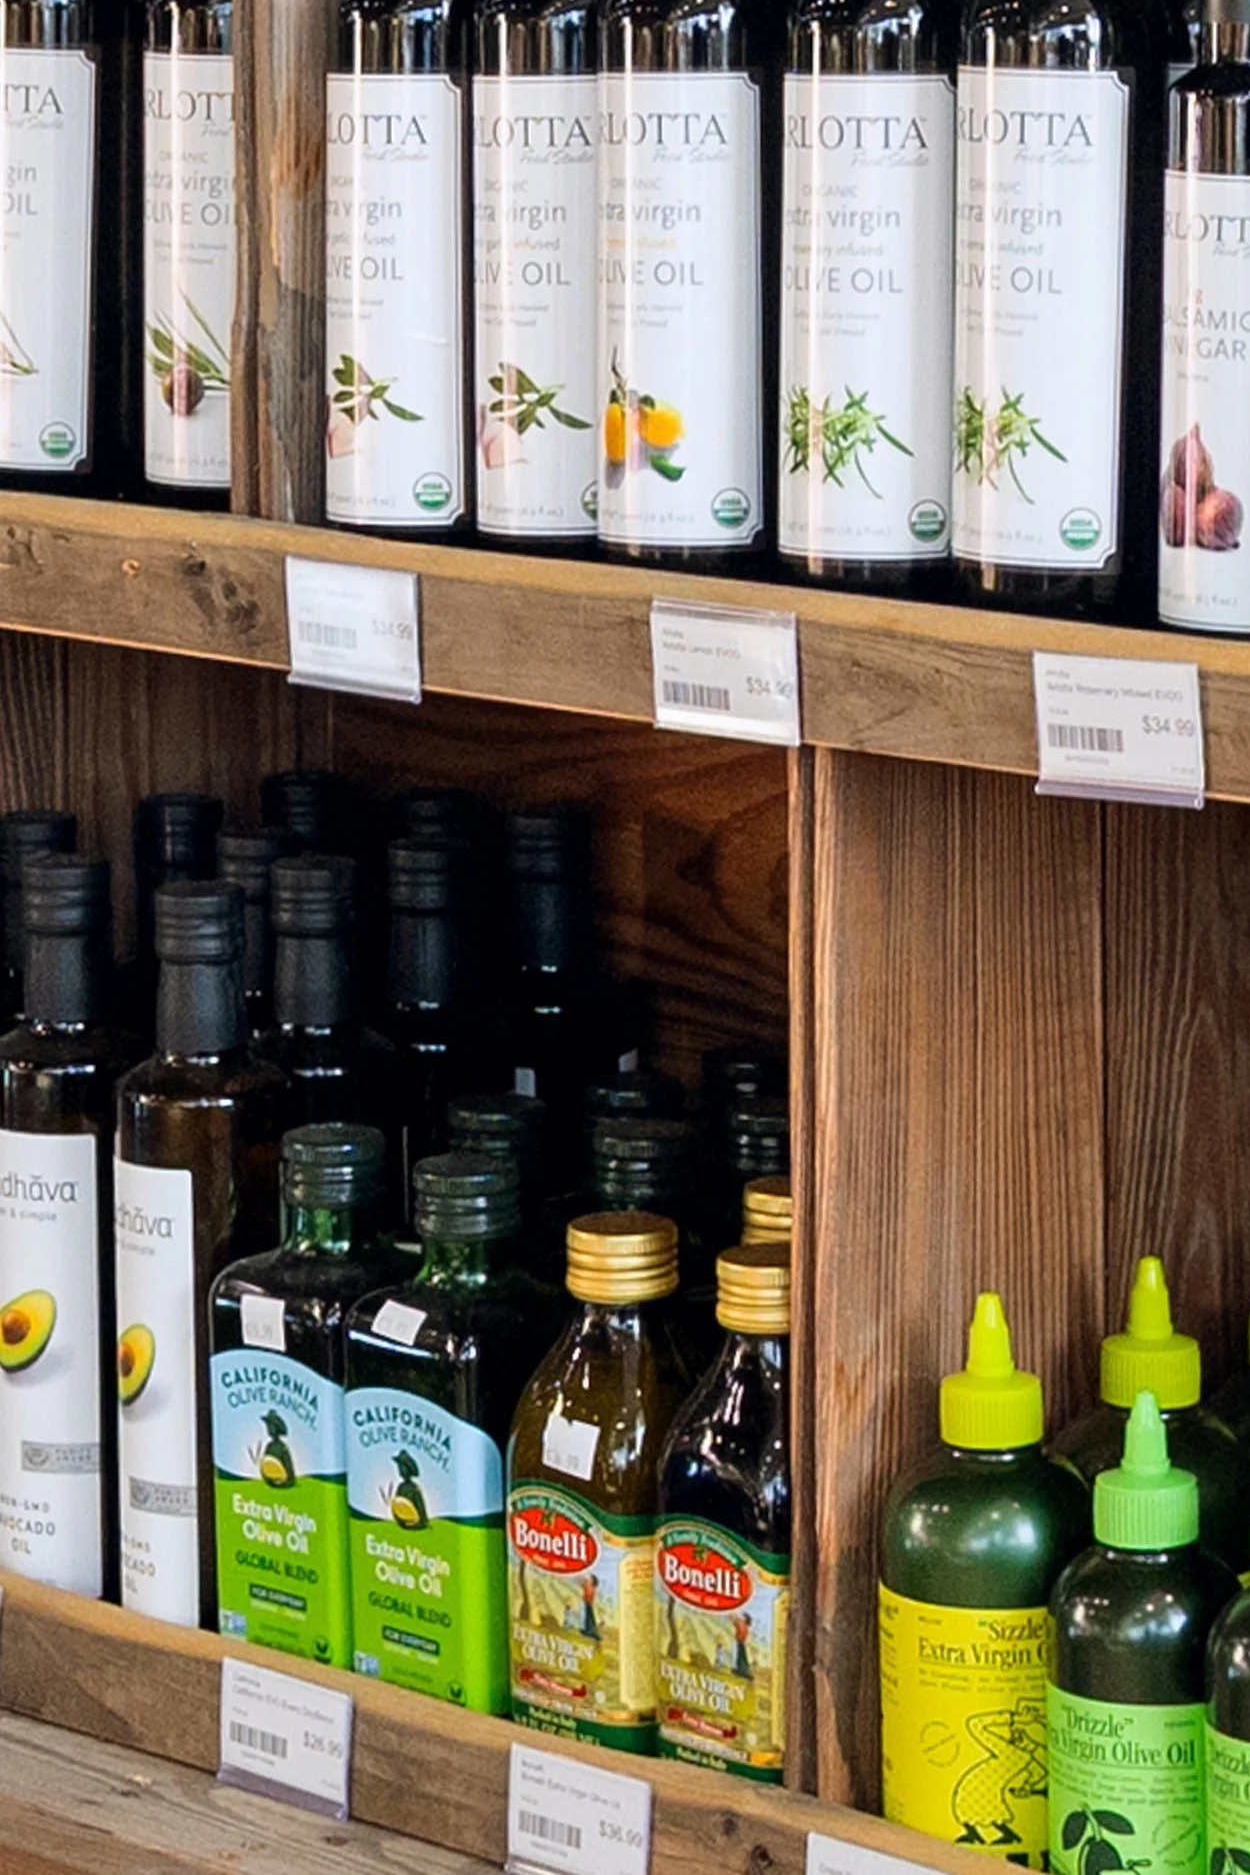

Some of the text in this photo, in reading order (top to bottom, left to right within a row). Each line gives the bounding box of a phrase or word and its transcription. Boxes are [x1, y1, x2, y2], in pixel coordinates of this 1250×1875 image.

[827, 206, 902, 238] virgin
[361, 255, 404, 282] OIL
[521, 260, 572, 287] OIL
[653, 260, 704, 287] OIL
[850, 266, 904, 294] OIL
[1010, 265, 1063, 295] OIL
[1141, 714, 1196, 737] $34.99
[221, 1365, 320, 1413] CALIFORNIA
[226, 1383, 317, 1428] OLIVE RANCH
[353, 1404, 452, 1451] CALIFORNIA
[358, 1426, 448, 1472] OLIVE RANCH
[232, 1492, 318, 1535] Extra Virgin
[241, 1518, 310, 1556] Olive Oil
[365, 1533, 452, 1577] Extra Virgin
[513, 1516, 588, 1563] Bonelli
[234, 1549, 283, 1576] GLOBAL
[375, 1560, 443, 1599] Olive Oil
[663, 1552, 742, 1601] Bonelli
[367, 1589, 453, 1629] GLOBAL BLEND
[918, 1636, 1032, 1671] Extra Virgin
[1111, 1738, 1162, 1767] Olive
[1166, 1739, 1197, 1766] Oil
